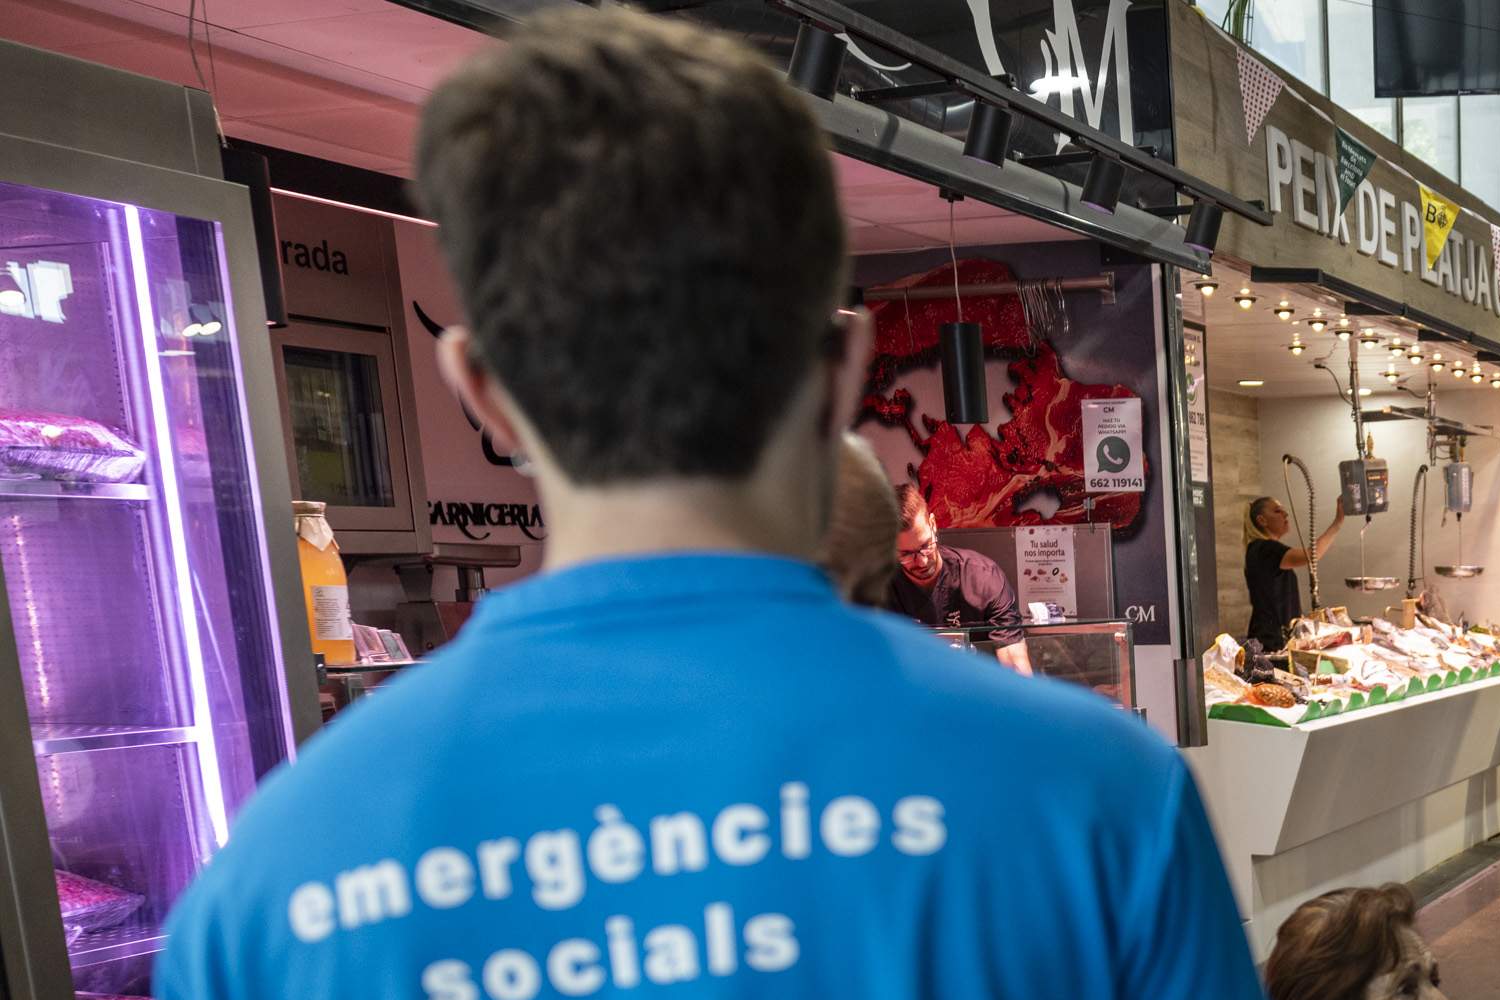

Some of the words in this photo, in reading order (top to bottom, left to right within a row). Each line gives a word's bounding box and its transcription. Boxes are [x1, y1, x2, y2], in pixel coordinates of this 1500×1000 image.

[1266, 124, 1350, 244] PEIX
[1357, 178, 1398, 267] DE
[1426, 202, 1437, 224] B
[1090, 478, 1110, 488] 662
[1112, 478, 1143, 488] 119141
[427, 500, 546, 541] ARNICERIA
[1037, 549, 1066, 559] importa
[1039, 540, 1059, 548] salud
[1124, 605, 1156, 623] CM
[287, 782, 947, 944] emergències
